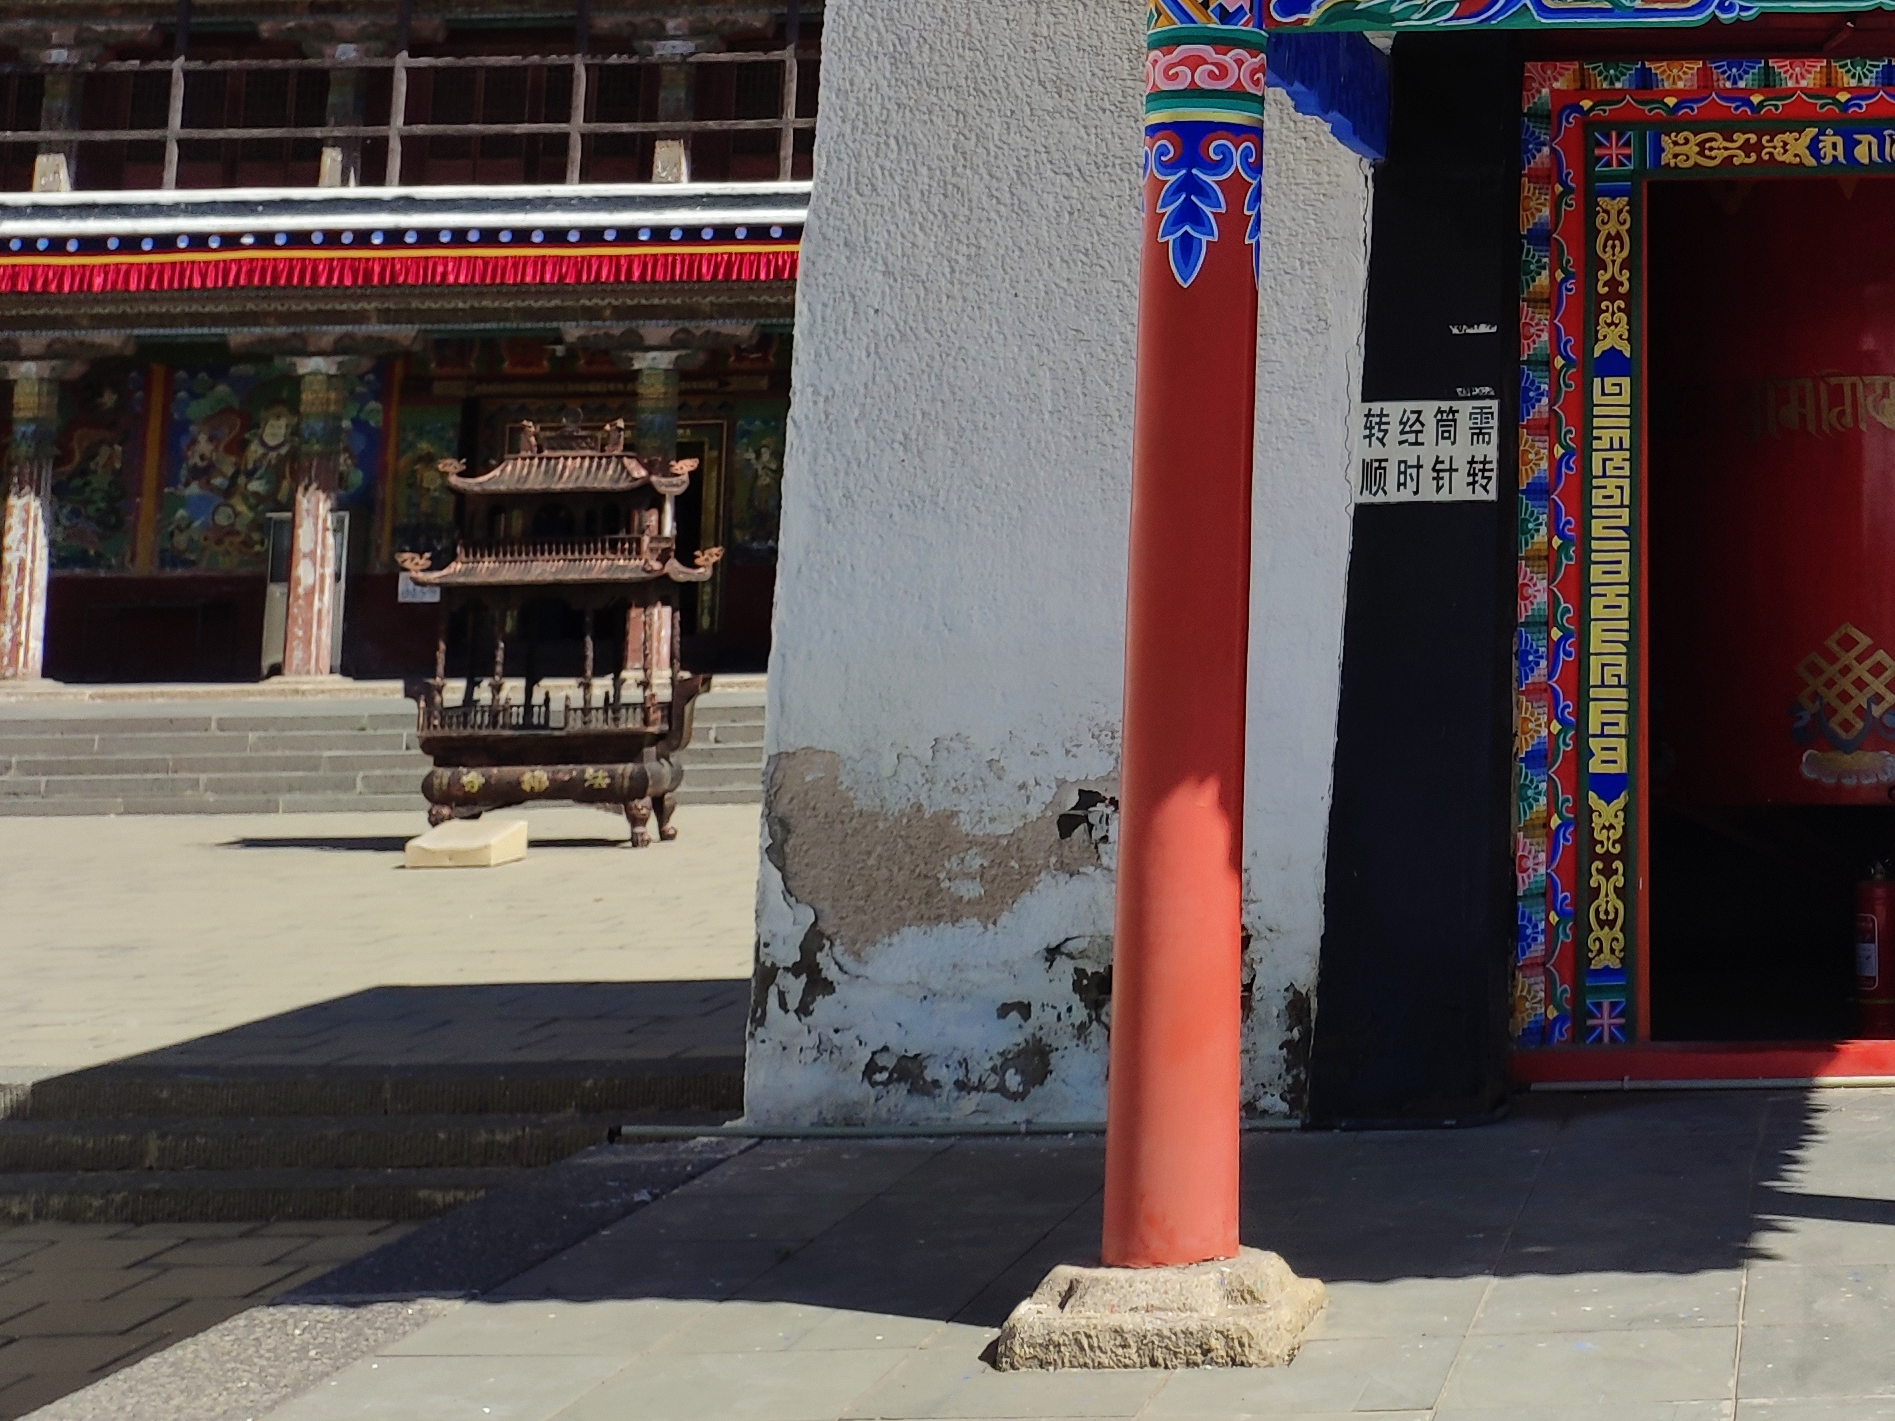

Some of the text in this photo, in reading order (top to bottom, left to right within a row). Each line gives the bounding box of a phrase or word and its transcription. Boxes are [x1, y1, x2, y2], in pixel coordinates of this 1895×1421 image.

[1362, 406, 1495, 448] 转经筒需
[1359, 454, 1495, 497] 顺时针转
